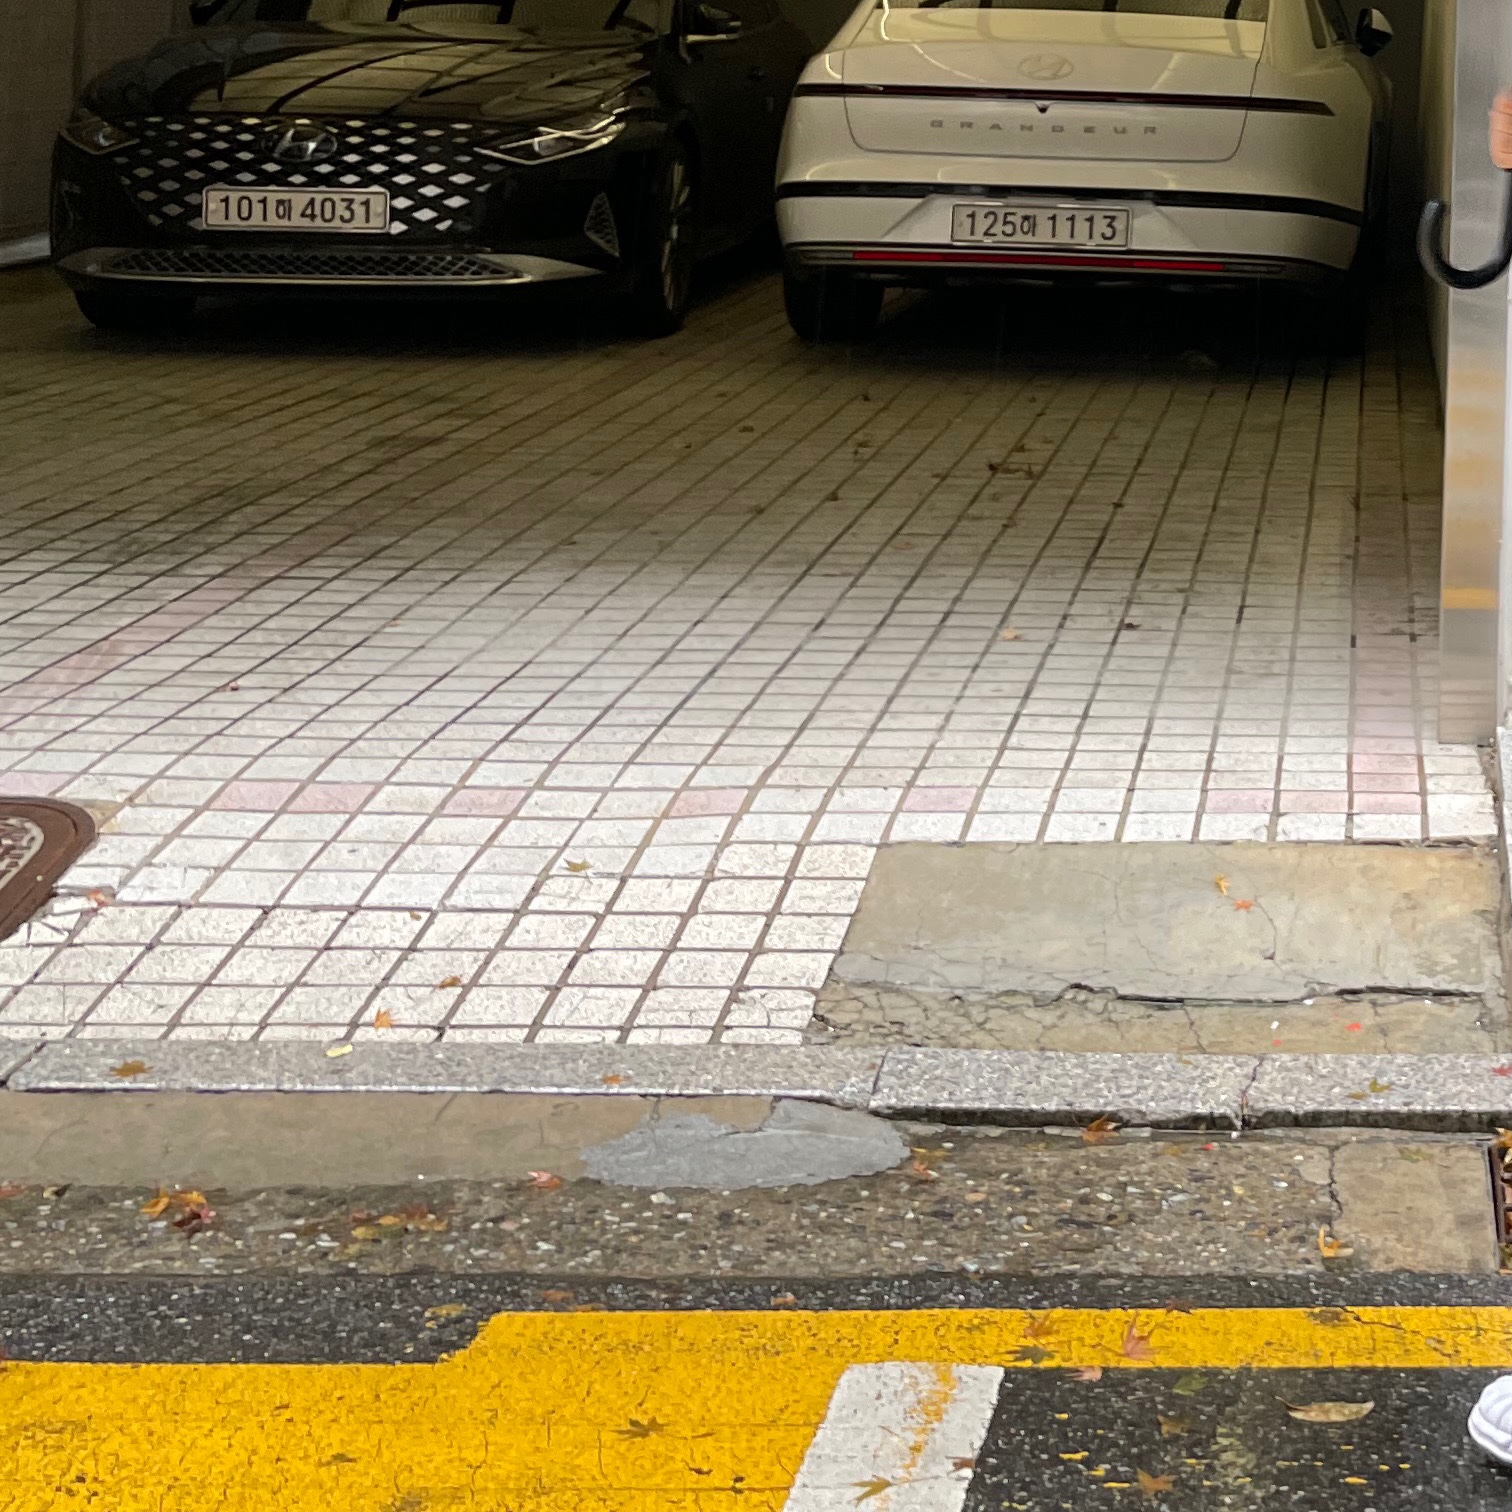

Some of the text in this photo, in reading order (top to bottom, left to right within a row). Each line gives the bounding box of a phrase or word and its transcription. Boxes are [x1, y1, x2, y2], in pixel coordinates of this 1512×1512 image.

[930, 119, 1158, 135] GRANDEUR
[300, 196, 372, 224] 4031
[1047, 213, 1118, 240] 1113
